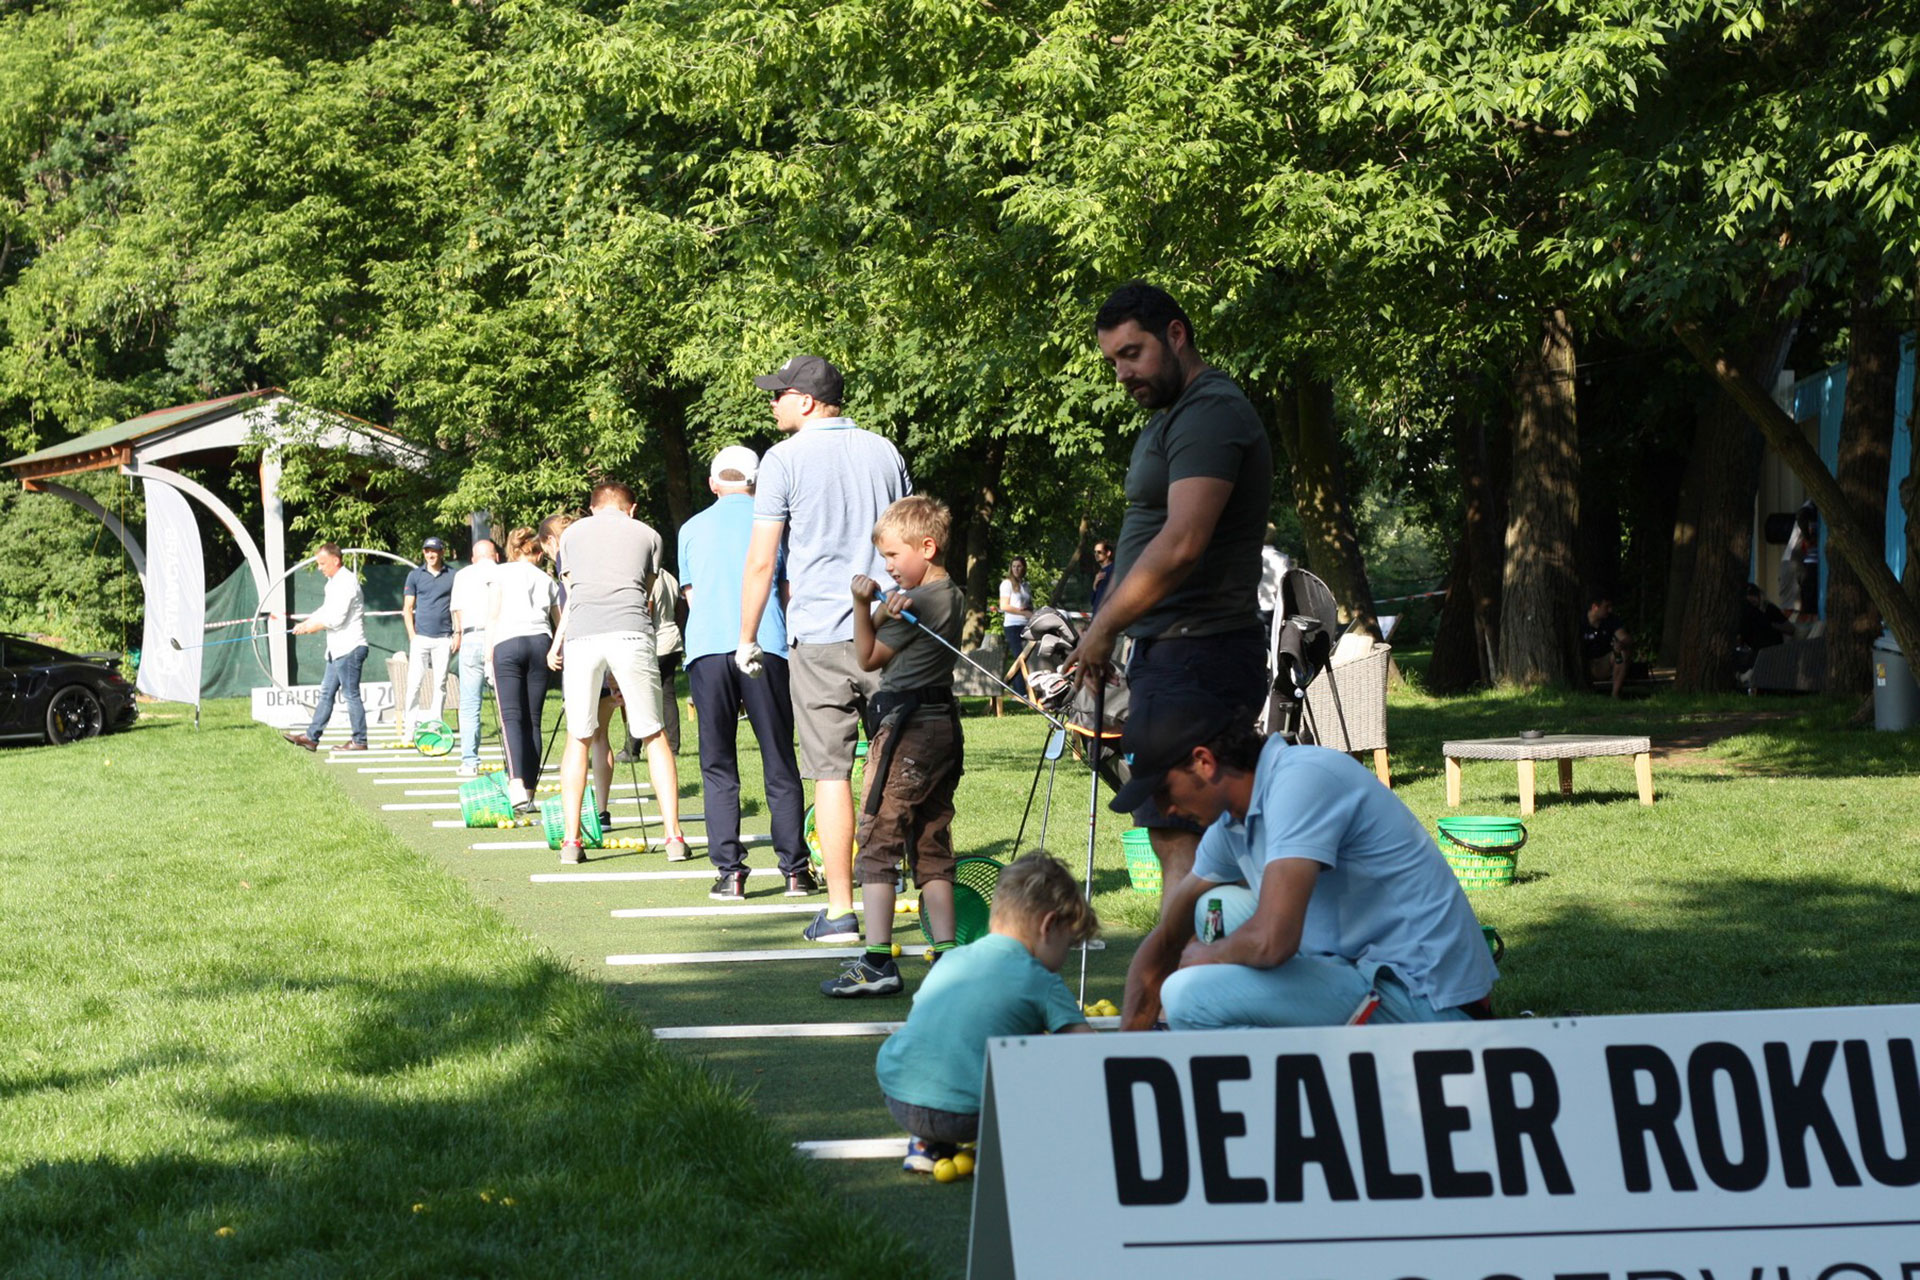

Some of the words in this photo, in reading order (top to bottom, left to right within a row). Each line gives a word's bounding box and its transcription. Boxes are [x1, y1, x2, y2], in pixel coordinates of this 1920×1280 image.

[266, 689, 321, 706] DEALER
[1103, 1047, 1575, 1207] DEALER
[1605, 1037, 1920, 1193] ROKU
